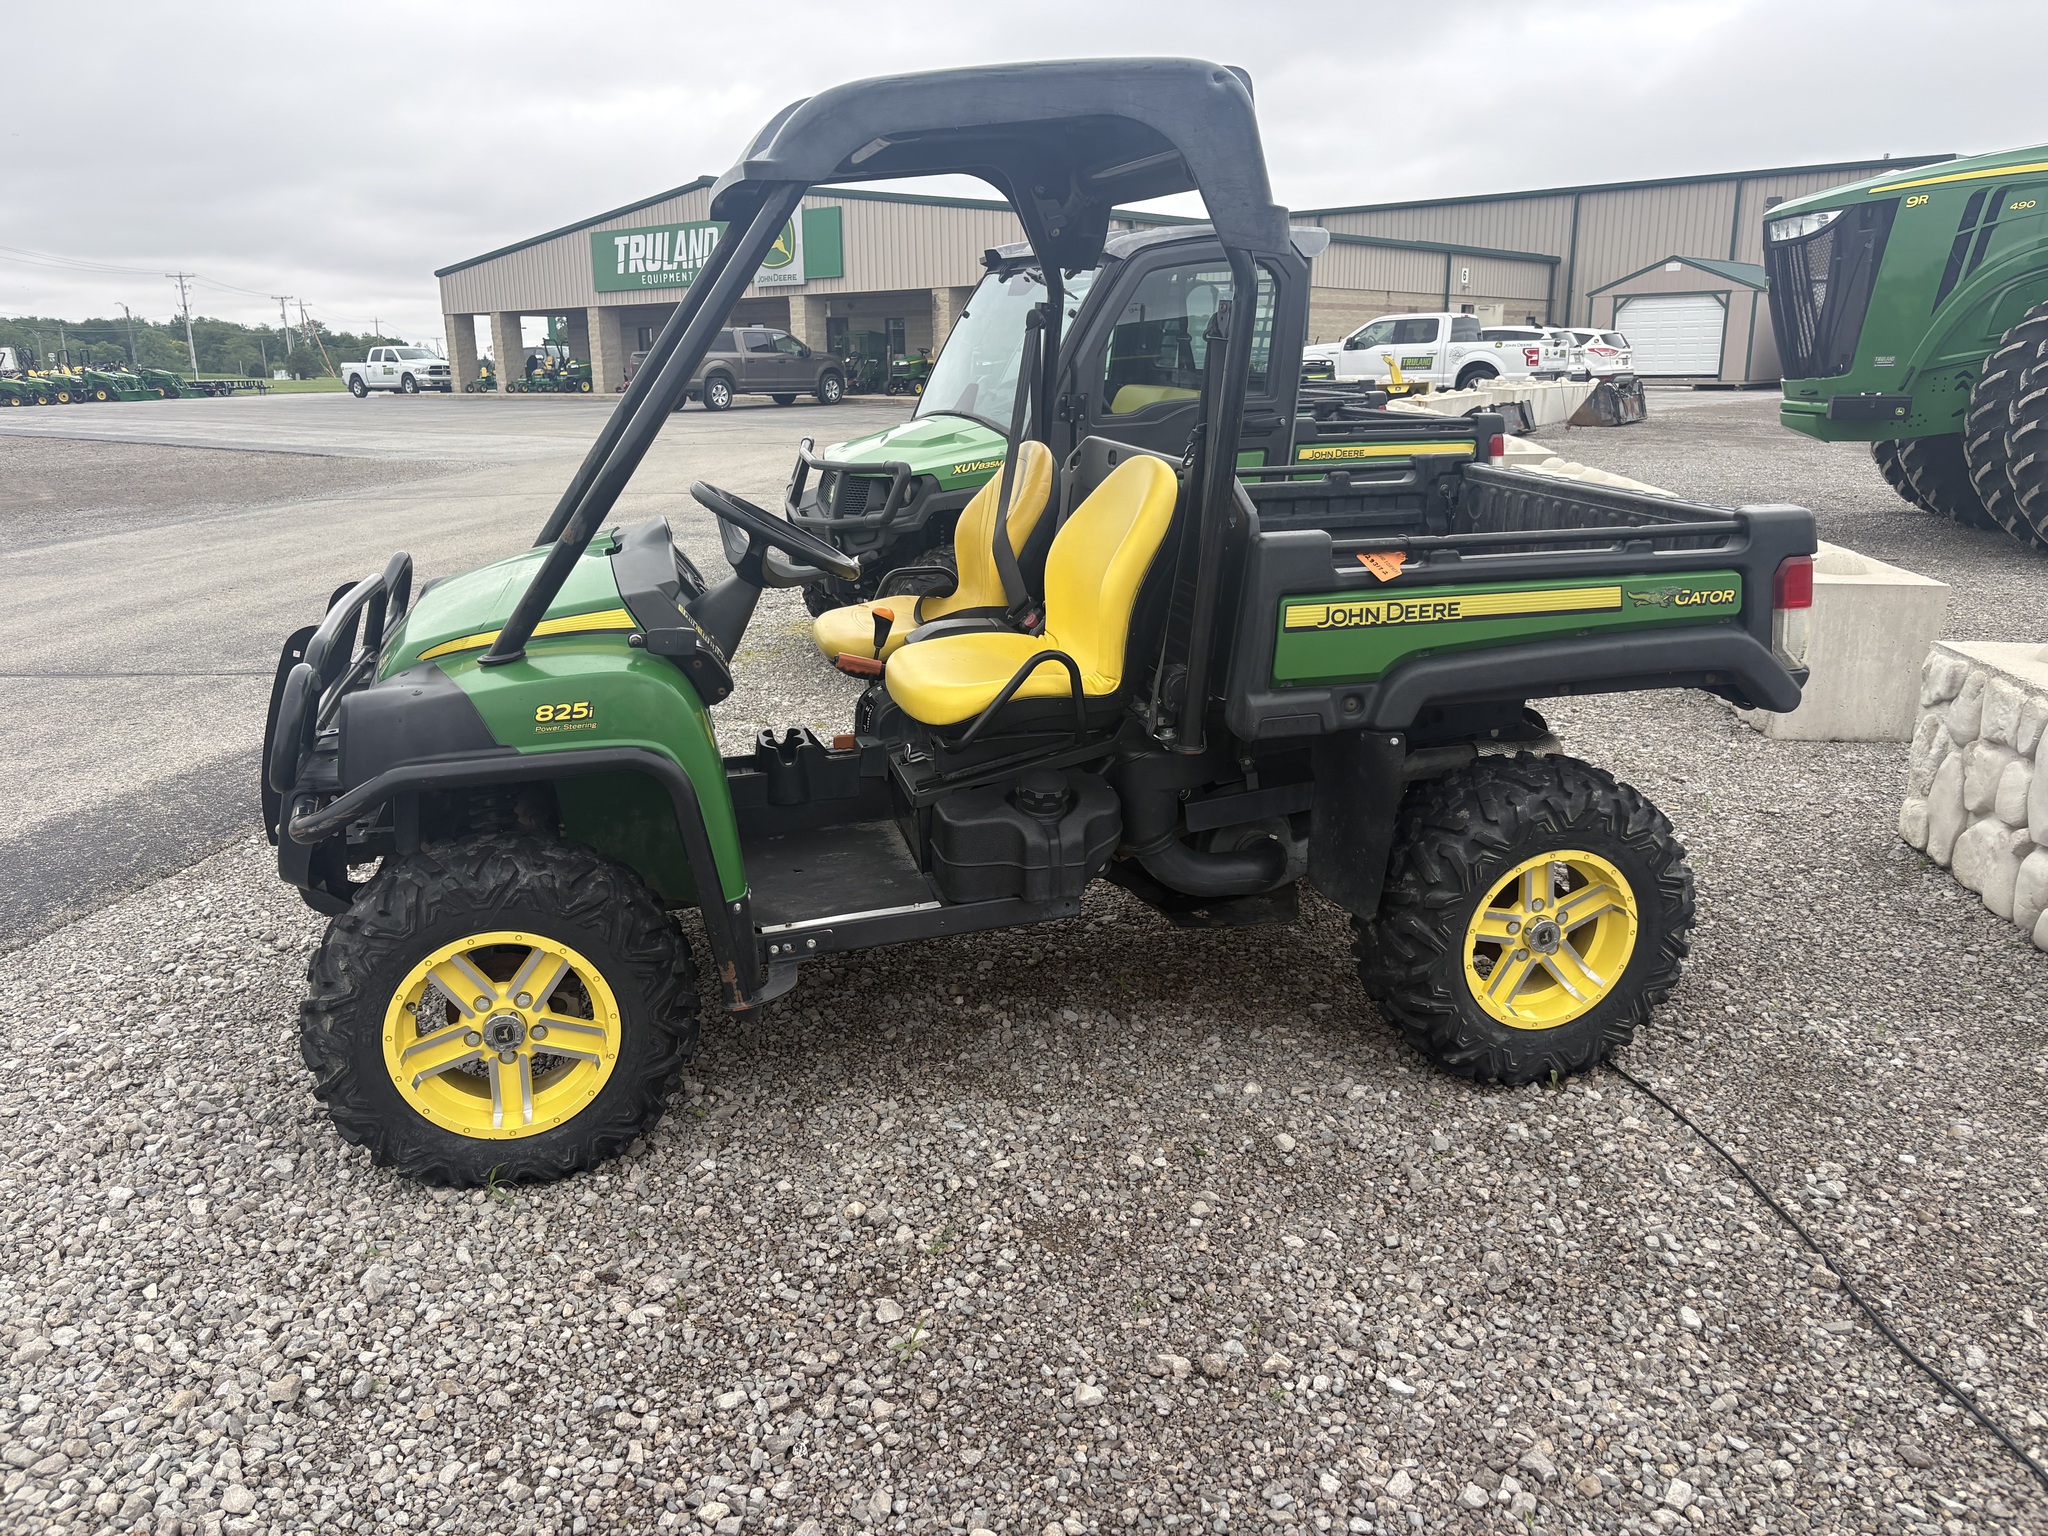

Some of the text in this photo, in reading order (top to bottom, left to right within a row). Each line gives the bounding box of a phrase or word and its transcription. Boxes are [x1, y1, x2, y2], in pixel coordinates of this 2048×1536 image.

[1905, 194, 1929, 208] 9R
[2009, 200, 2037, 211] 490
[614, 226, 719, 275] TRULAND
[641, 271, 694, 285] EQUIPMENT
[757, 273, 798, 284] JOHN DEERE
[1462, 270, 1468, 281] 6
[1309, 448, 1365, 459] JOHN DEERE
[1675, 589, 1736, 606] GATOR
[1317, 601, 1461, 626] JOHN DEERE
[534, 701, 594, 722] 825i
[535, 722, 597, 733] Power Steering
